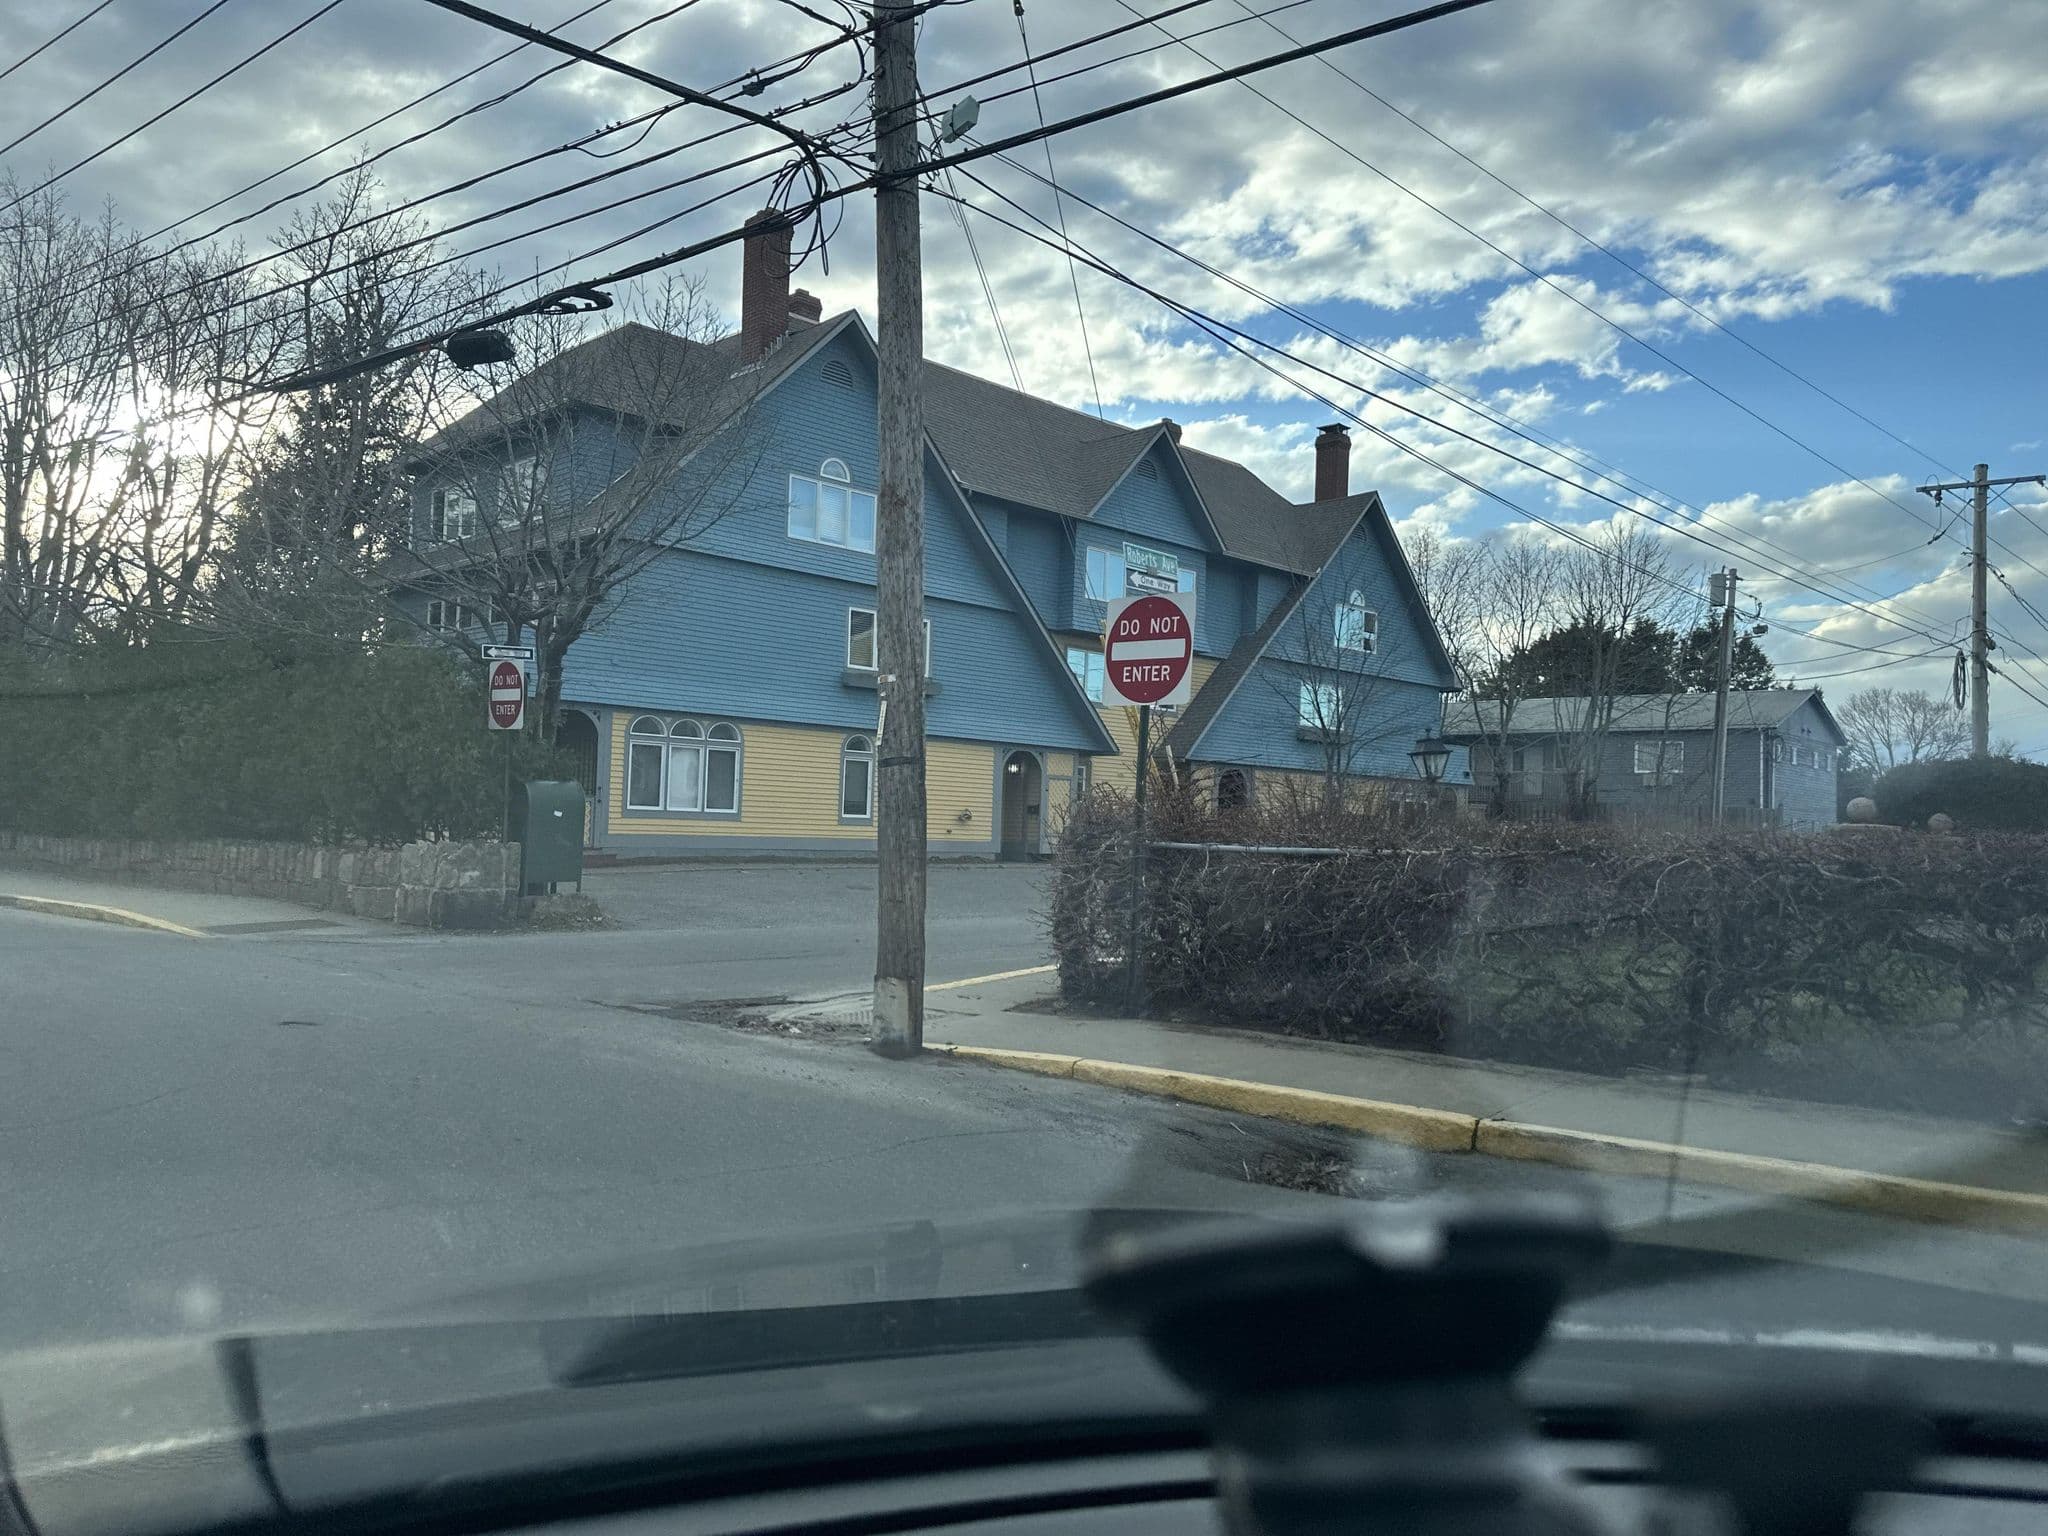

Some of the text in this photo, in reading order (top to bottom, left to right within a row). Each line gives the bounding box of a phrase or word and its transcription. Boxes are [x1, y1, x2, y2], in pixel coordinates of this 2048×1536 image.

[1126, 546, 1176, 573] Roberts Ave
[1120, 616, 1180, 636] DO NOT
[494, 674, 519, 686] DO NOT
[1122, 665, 1170, 683] ENTER
[496, 704, 515, 715] ENTER
